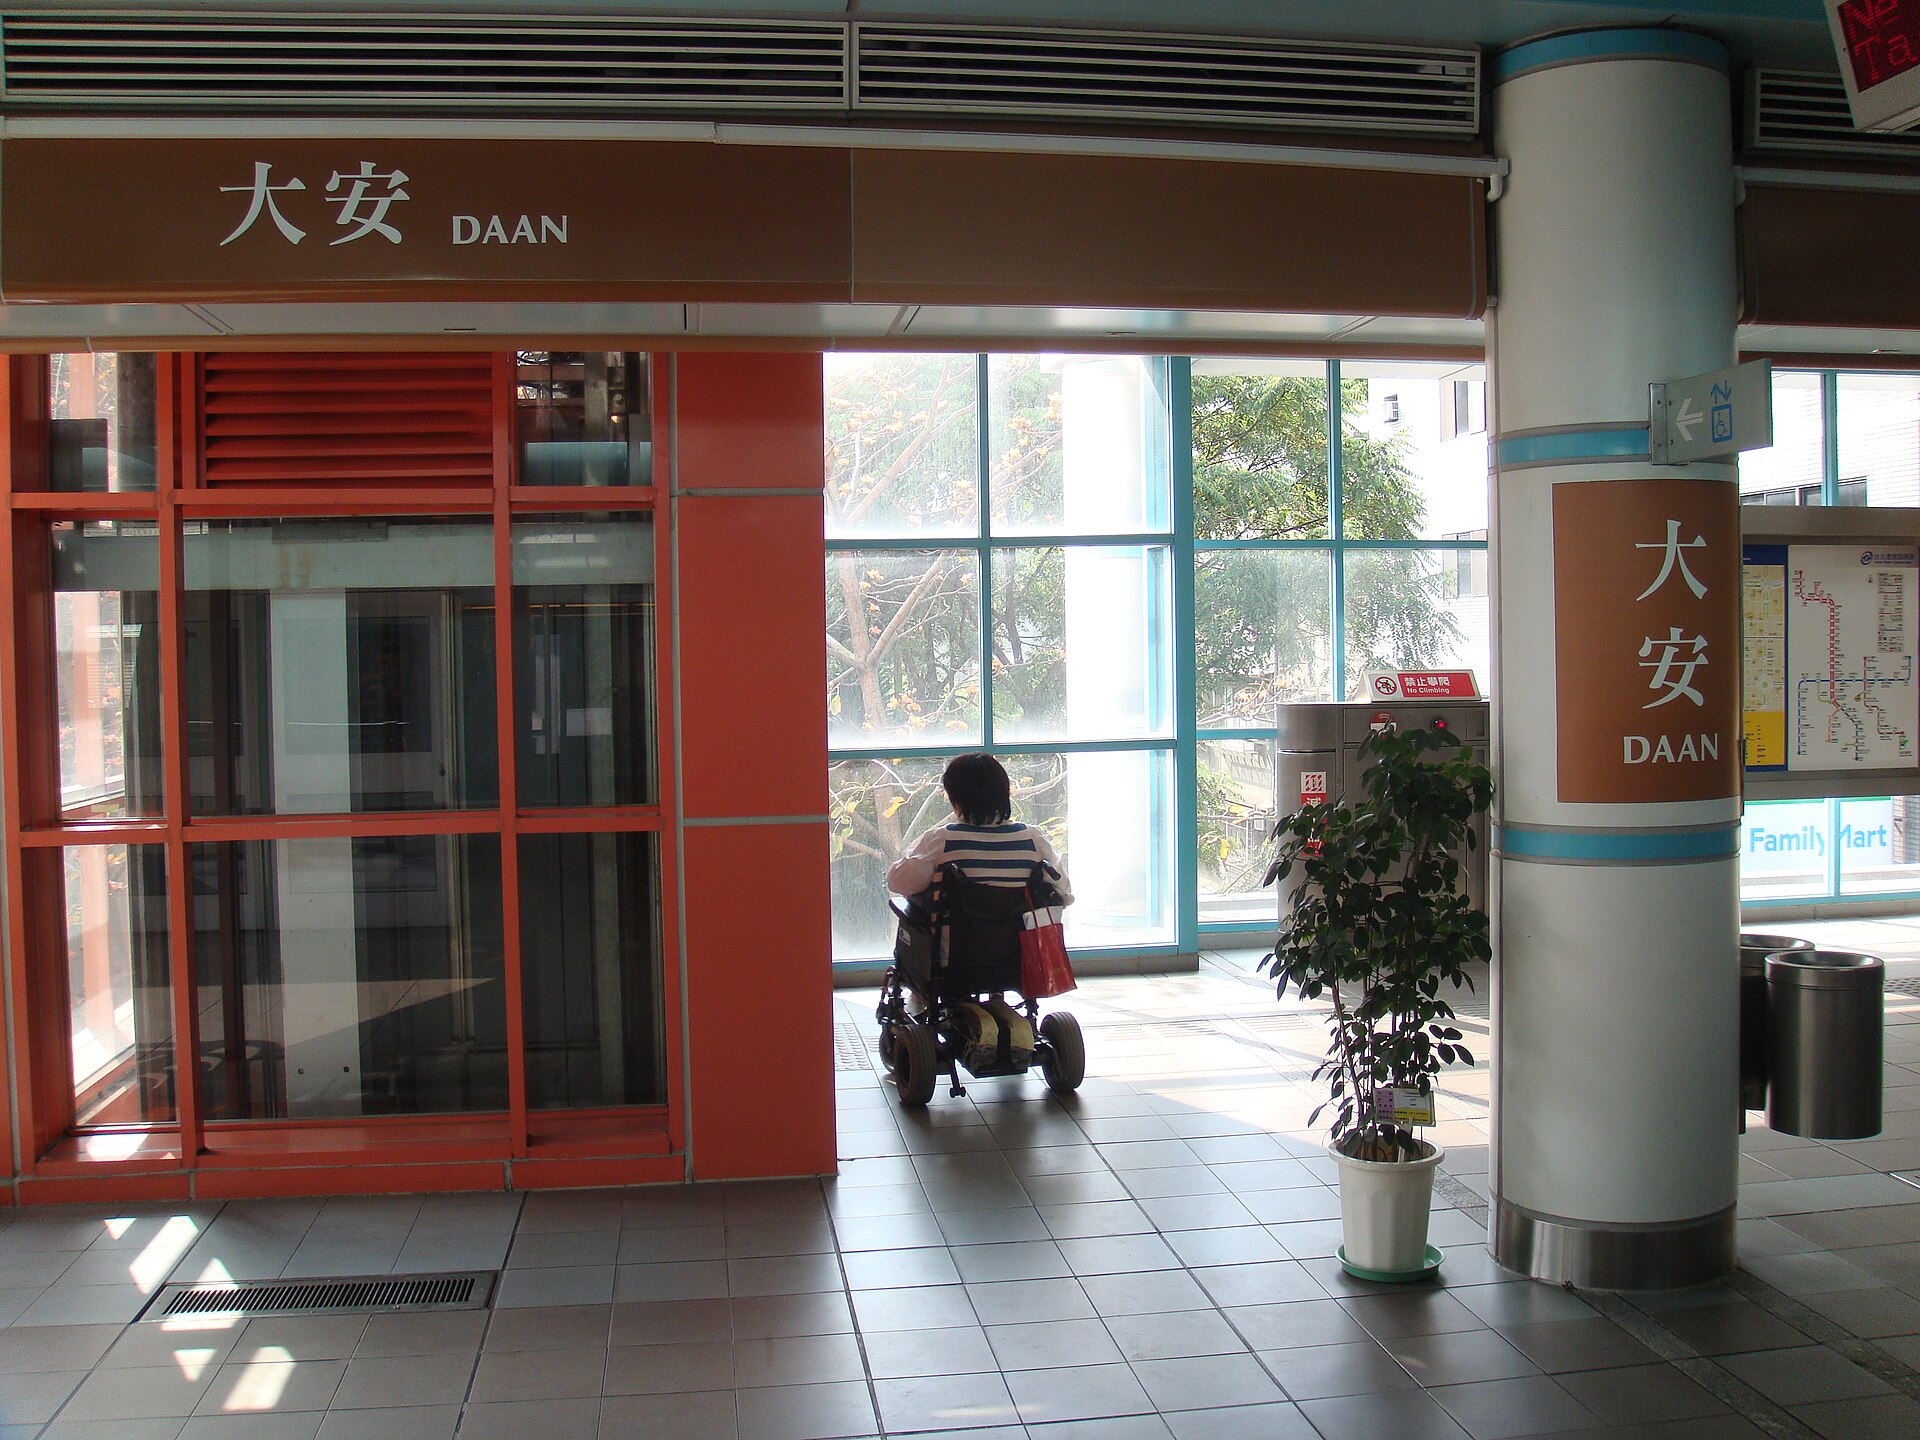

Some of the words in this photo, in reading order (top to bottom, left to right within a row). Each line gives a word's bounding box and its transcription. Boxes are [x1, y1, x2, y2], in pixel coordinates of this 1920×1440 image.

[219, 160, 411, 247] 大安
[452, 214, 568, 245] DAAN
[1634, 519, 1709, 710] 大安
[1623, 733, 1719, 764] DAAN
